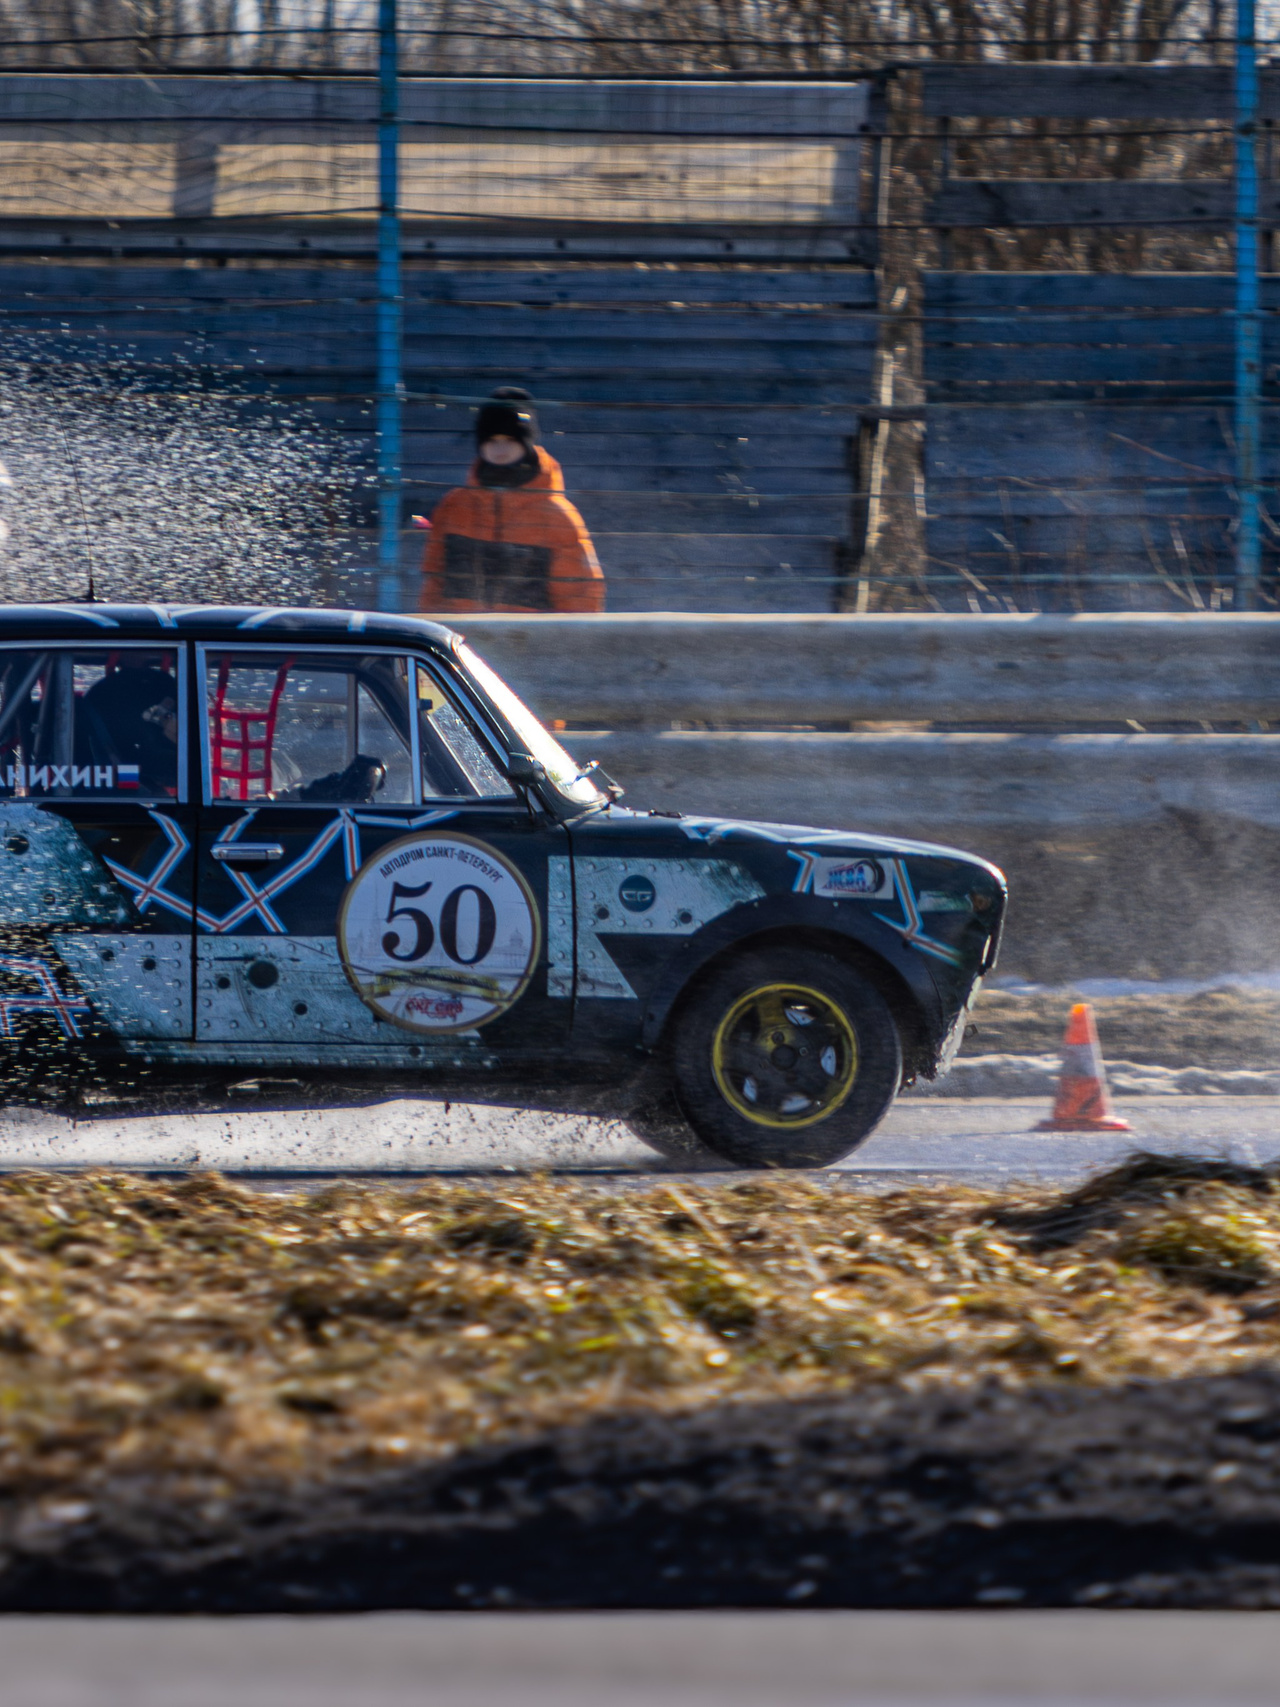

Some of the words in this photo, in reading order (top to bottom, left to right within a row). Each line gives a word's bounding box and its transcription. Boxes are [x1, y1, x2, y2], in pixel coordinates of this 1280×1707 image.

[379, 847, 425, 879] АВТОДРОМ
[425, 846, 504, 883] САНКТ-ПЕТЕРБУРГ
[381, 881, 497, 966] 50
